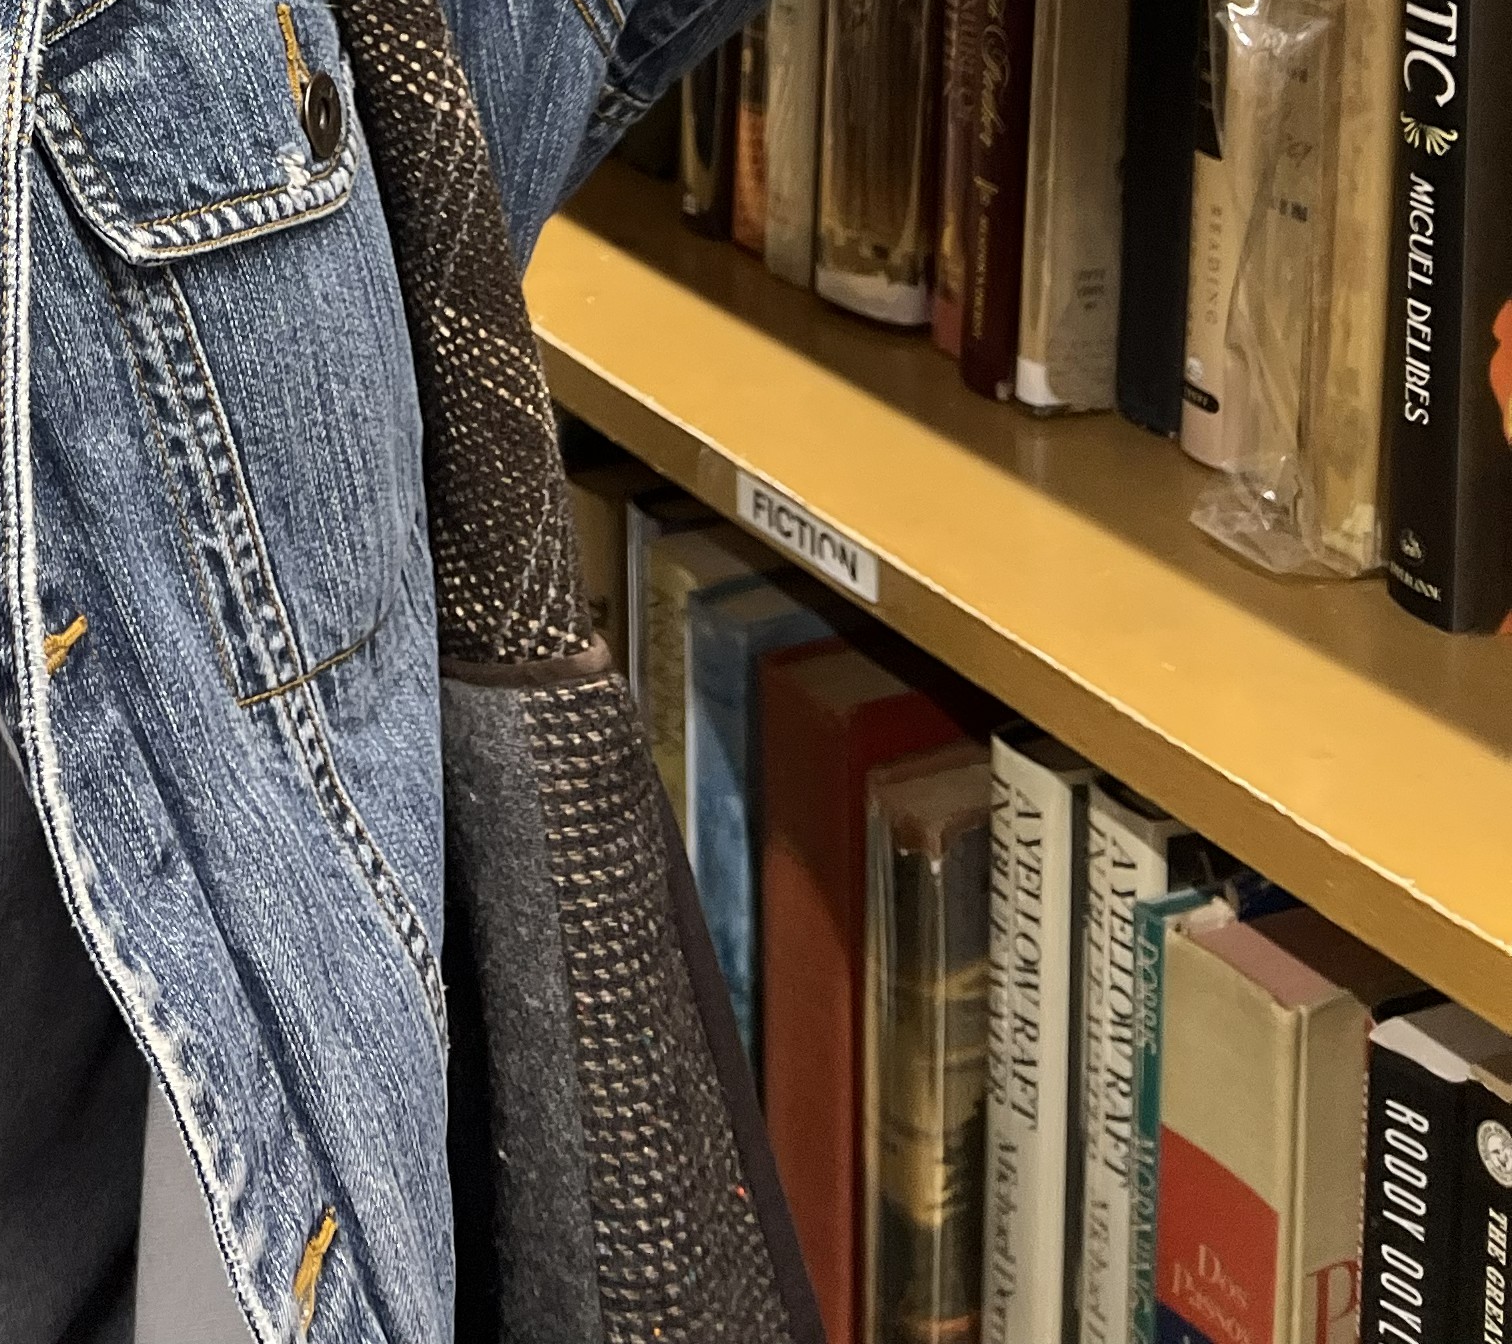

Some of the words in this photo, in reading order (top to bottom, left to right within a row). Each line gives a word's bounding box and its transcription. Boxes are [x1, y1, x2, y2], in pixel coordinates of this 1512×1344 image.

[1406, 170, 1436, 291] MIGUEL
[1403, 295, 1434, 427] DELIBES
[752, 489, 857, 583] FICTION
[990, 771, 1011, 829] IN
[1014, 786, 1042, 819] A
[1111, 836, 1137, 870] A
[1013, 835, 1043, 1009] YELLOW
[1108, 885, 1136, 1056] YELLOW
[987, 952, 1010, 1107] WATER
[1009, 1013, 1040, 1132] RAFT
[1103, 1066, 1133, 1188] RAFT
[1381, 1098, 1430, 1243] RODDY
[1377, 1243, 1425, 1344] DOYL
[1488, 1206, 1509, 1266] THE
